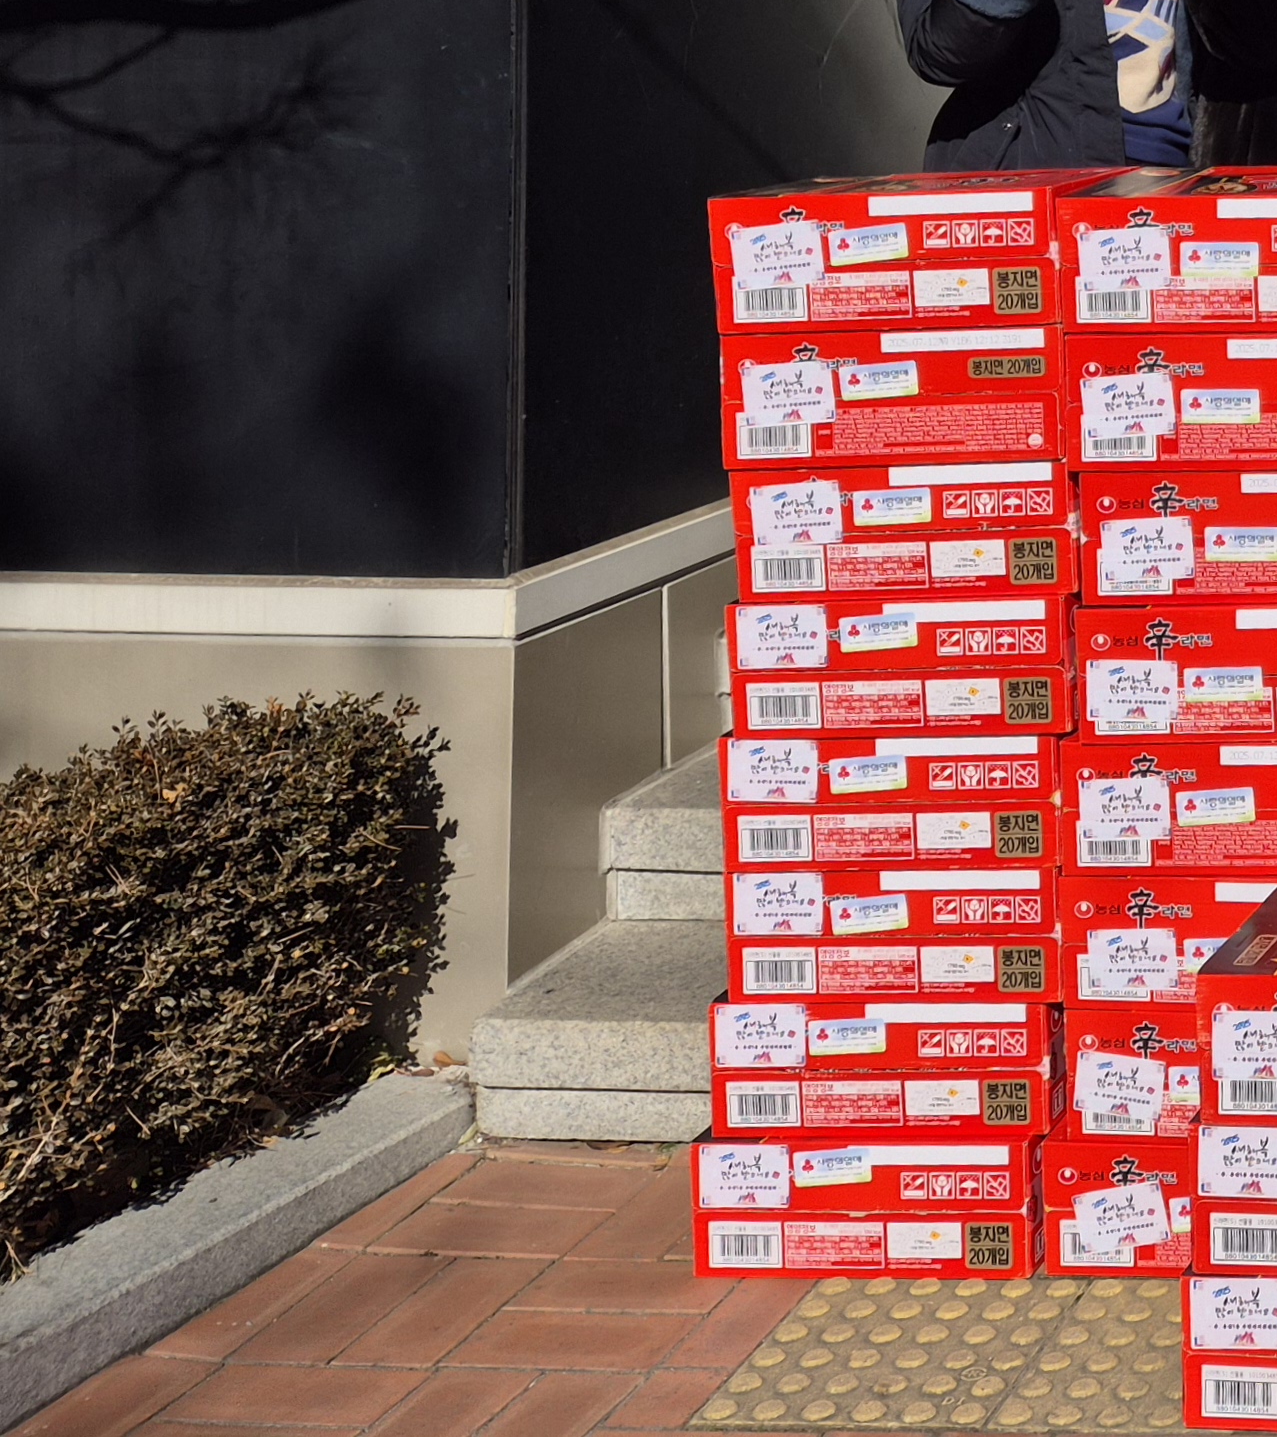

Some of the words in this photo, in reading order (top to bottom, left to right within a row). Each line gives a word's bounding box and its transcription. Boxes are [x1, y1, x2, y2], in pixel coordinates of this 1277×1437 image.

[1118, 498, 1146, 511] 농심
[1149, 482, 1184, 517] 辛
[1184, 494, 1218, 511] 라면
[1013, 541, 1054, 559] 봉지면
[1013, 562, 1054, 581] 20개입
[1111, 634, 1141, 648] 농심
[1144, 617, 1180, 659] 辛
[1181, 633, 1213, 649] 라면
[998, 814, 1039, 833] 봉지면
[998, 835, 1040, 854] 20개입
[1095, 903, 1122, 916] 농심
[1125, 888, 1160, 930] 辛
[1161, 902, 1194, 917] 라면
[1078, 1170, 1105, 1184] 농심
[1108, 1156, 1145, 1186] 辛
[1146, 1171, 1177, 1185] 라면
[969, 1226, 1010, 1244] 봉지면
[969, 1247, 1009, 1266] 20개입
